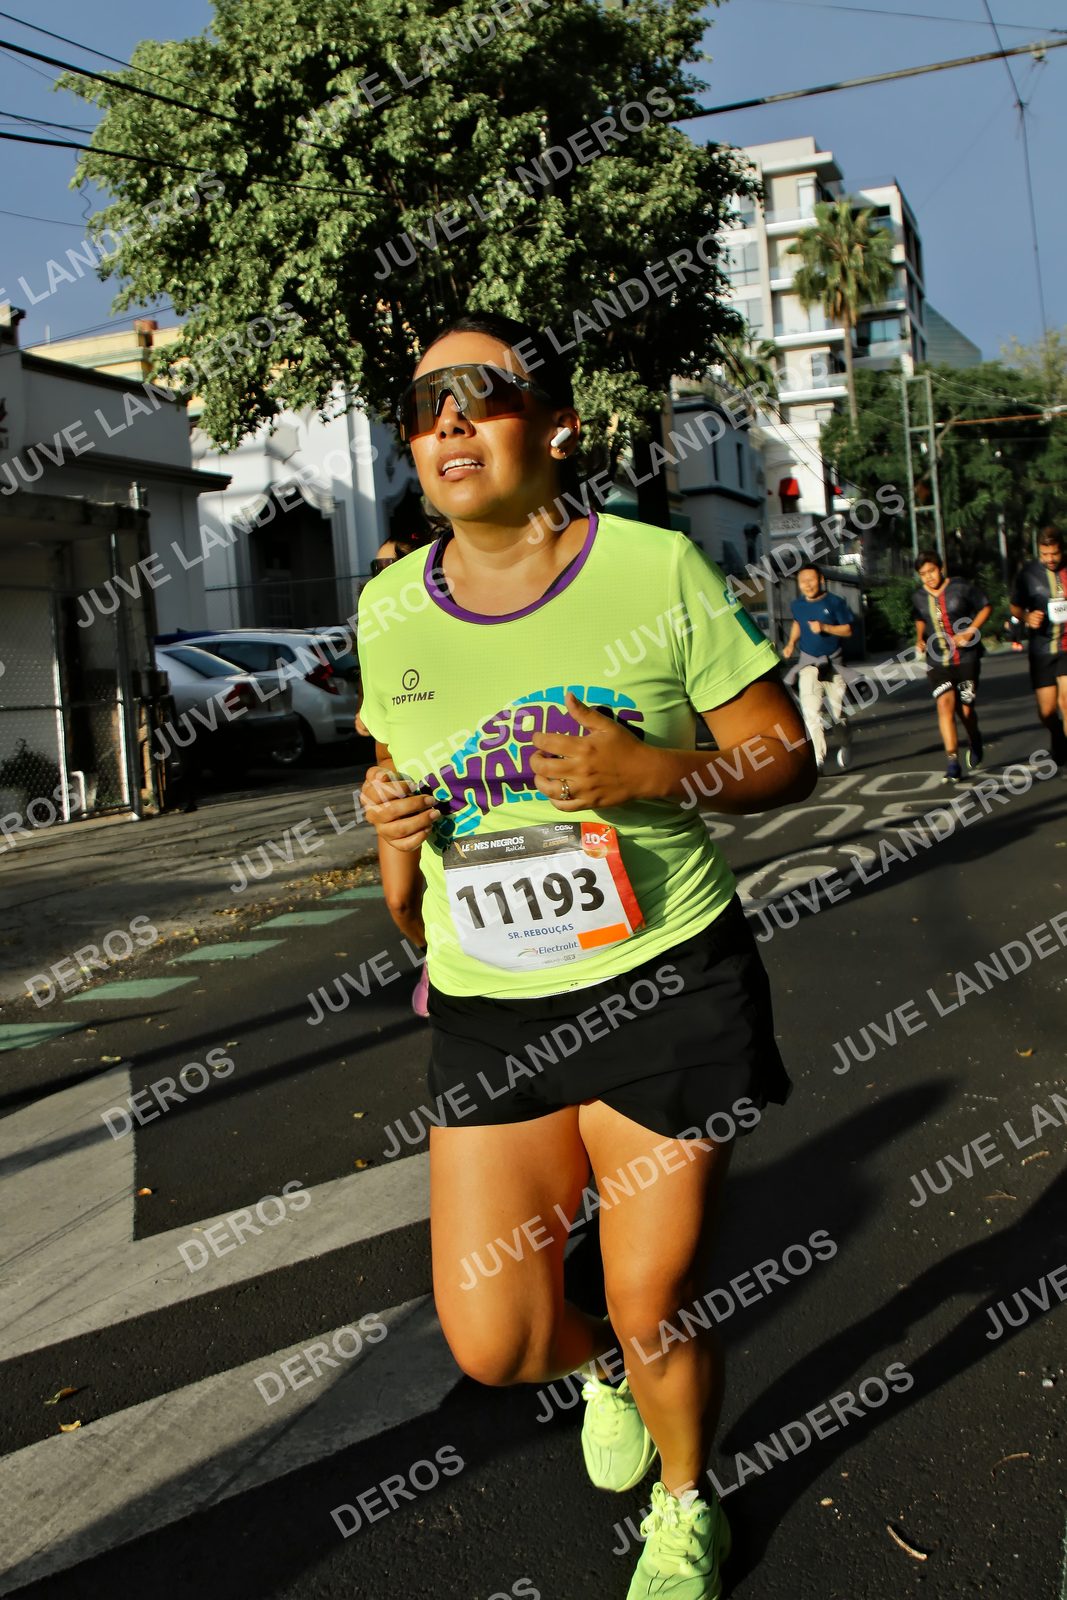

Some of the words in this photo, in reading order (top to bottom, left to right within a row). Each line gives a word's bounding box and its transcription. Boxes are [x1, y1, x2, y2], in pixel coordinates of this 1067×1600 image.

[392, 691, 435, 705] TOPTIME
[479, 705, 644, 751] SOMS
[490, 836, 524, 848] NEGROS
[455, 868, 605, 929] 11193
[508, 931, 523, 940] SR.
[524, 923, 575, 938] REBOUÇAS
[538, 941, 578, 955] Electrolit
